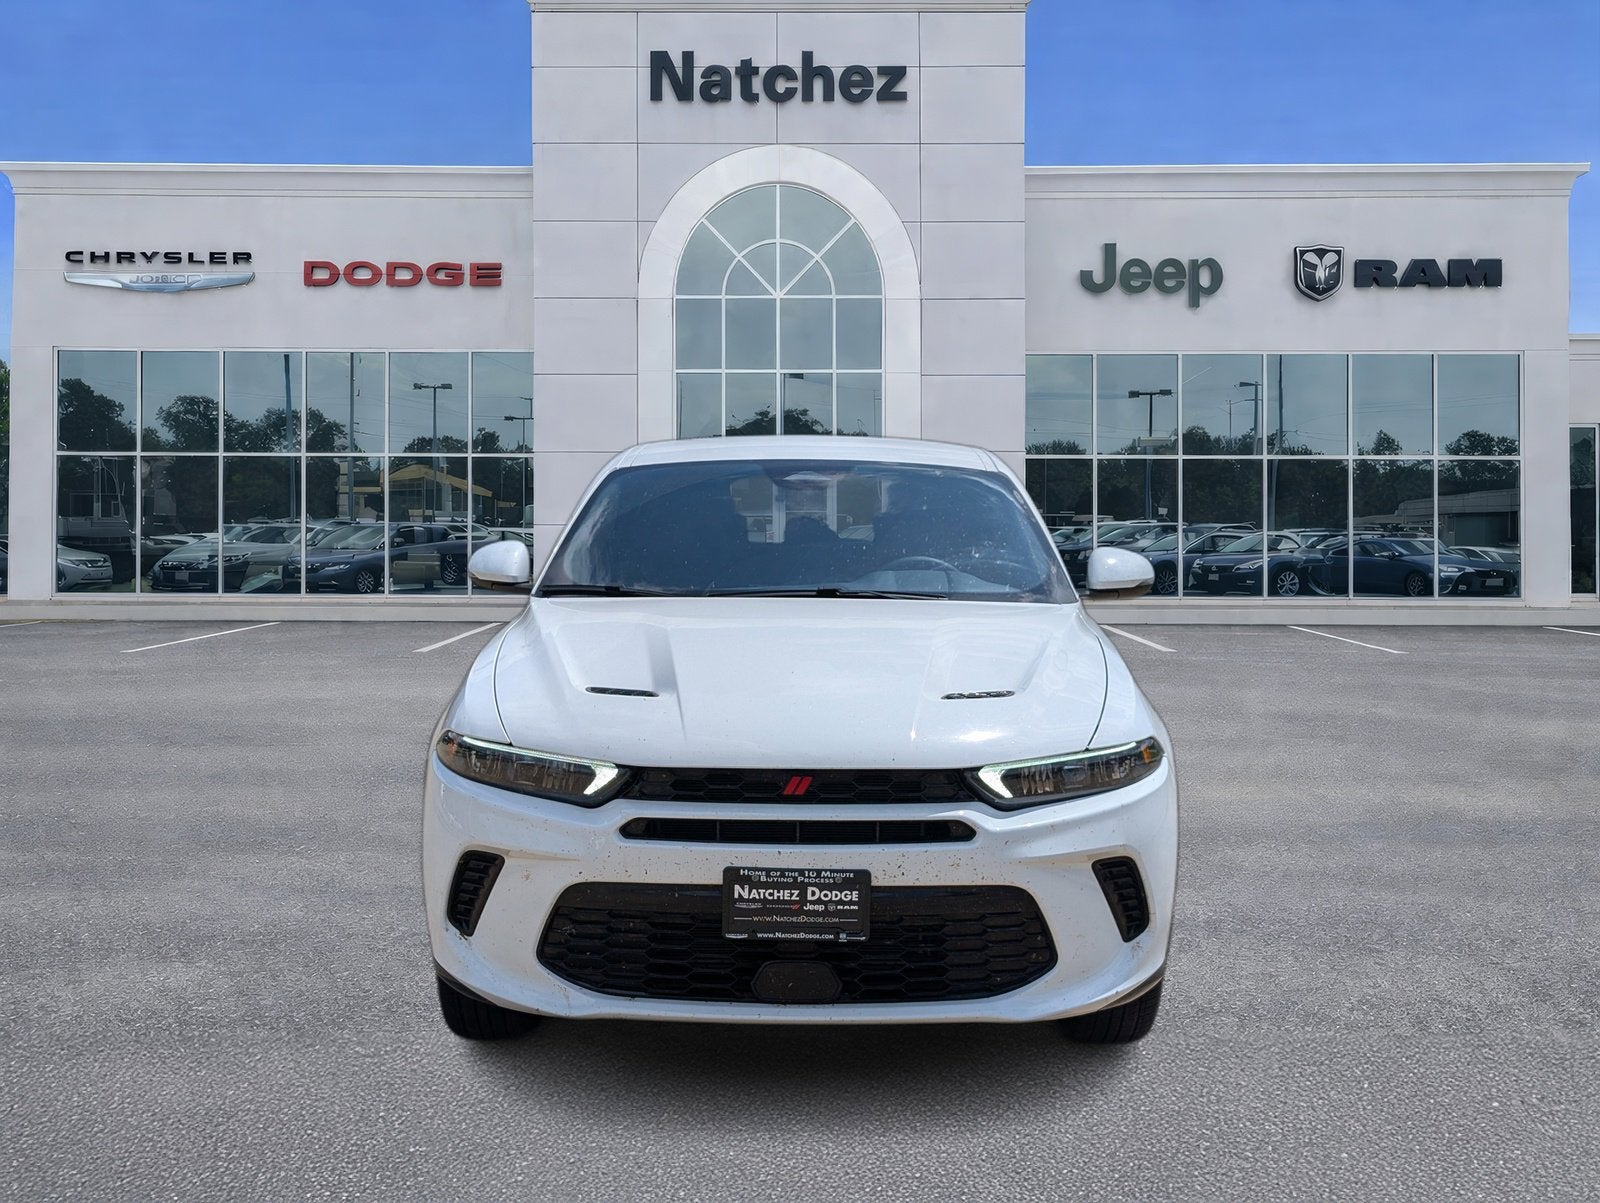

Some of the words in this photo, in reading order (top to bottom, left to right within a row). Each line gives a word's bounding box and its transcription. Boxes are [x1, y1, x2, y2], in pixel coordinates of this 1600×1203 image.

[650, 51, 907, 102] Natchez
[65, 251, 252, 265] CHRYSLER
[304, 261, 502, 287] DODGE
[1080, 243, 1223, 308] Jeep
[1354, 259, 1503, 288] RAM
[734, 884, 800, 900] NATCHEZ
[807, 886, 859, 901] DODGE
[803, 903, 825, 911] Jeep
